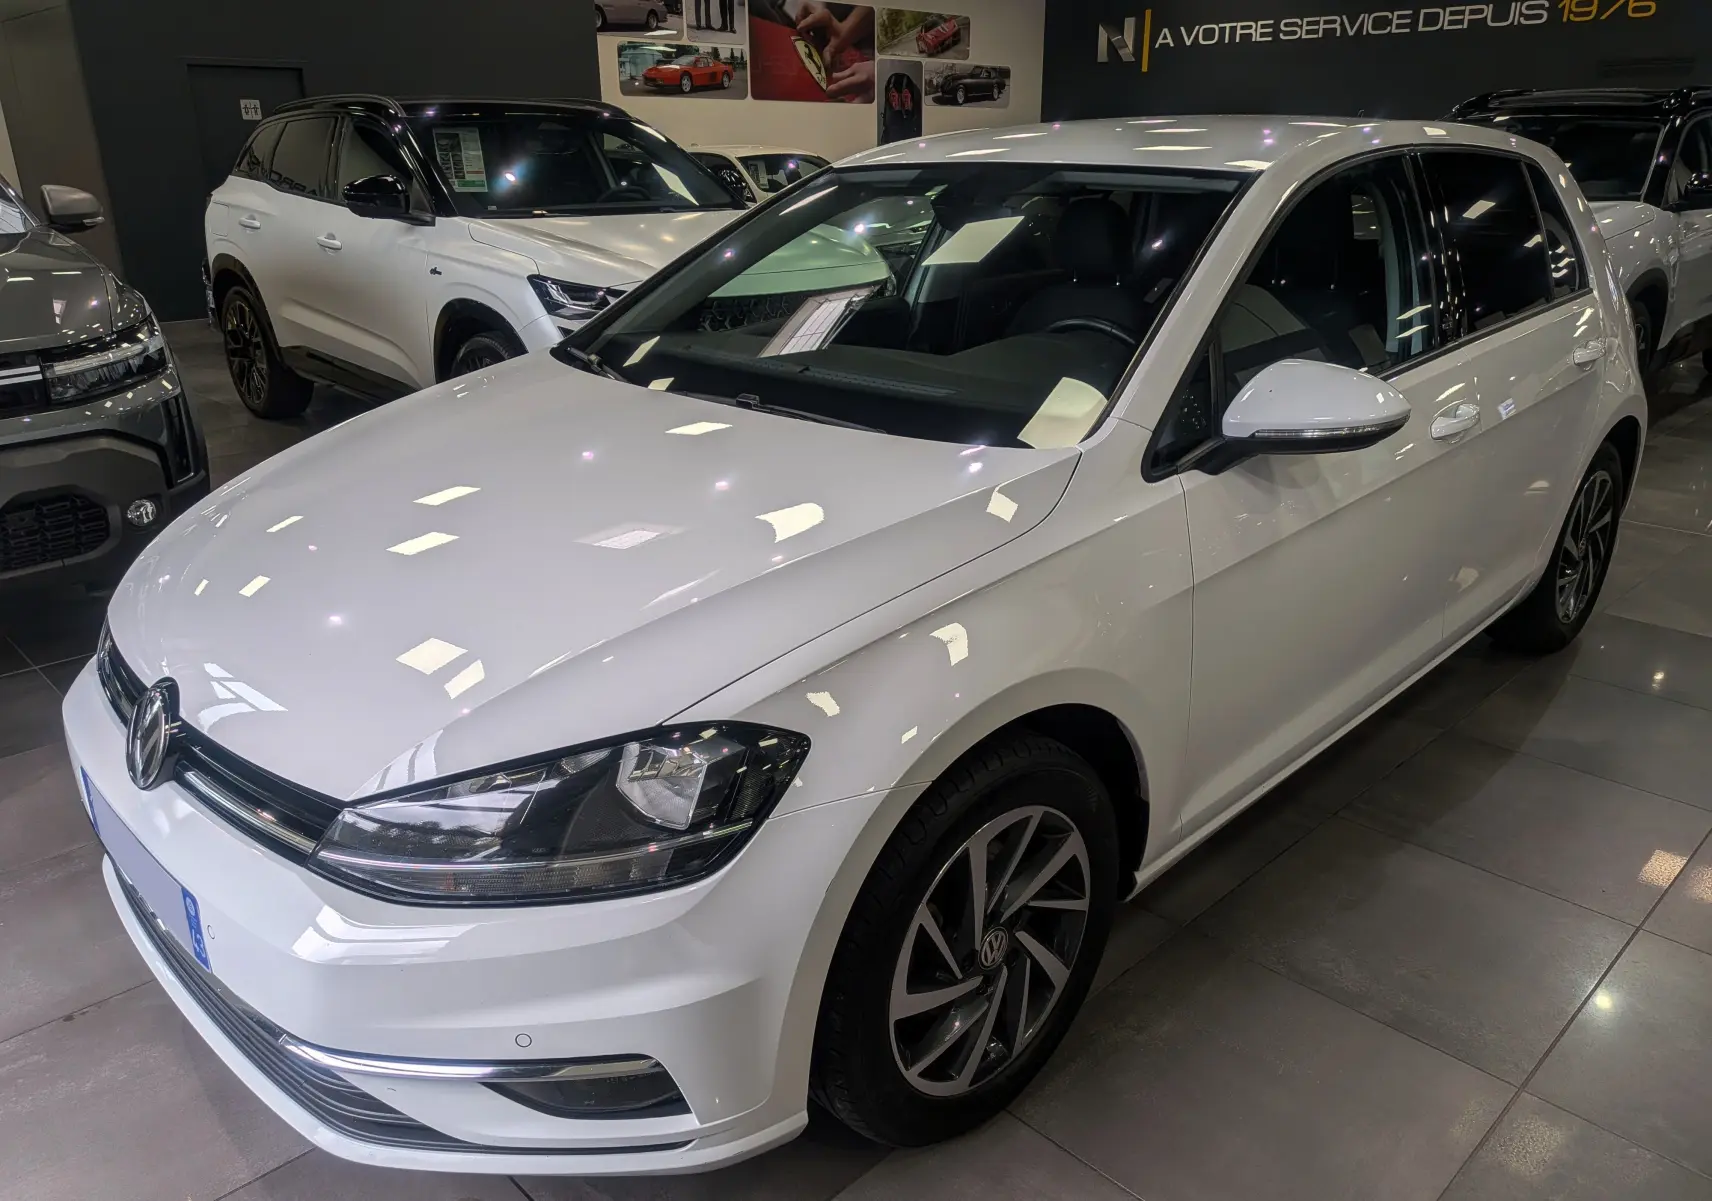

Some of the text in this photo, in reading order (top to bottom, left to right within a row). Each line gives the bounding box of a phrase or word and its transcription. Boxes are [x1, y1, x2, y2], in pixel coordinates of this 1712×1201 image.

[1154, 27, 1175, 48] A
[1180, 20, 1274, 46] VOTRE
[1279, 10, 1414, 40] SERVICE
[1417, 0, 1550, 32] DEPUIS
